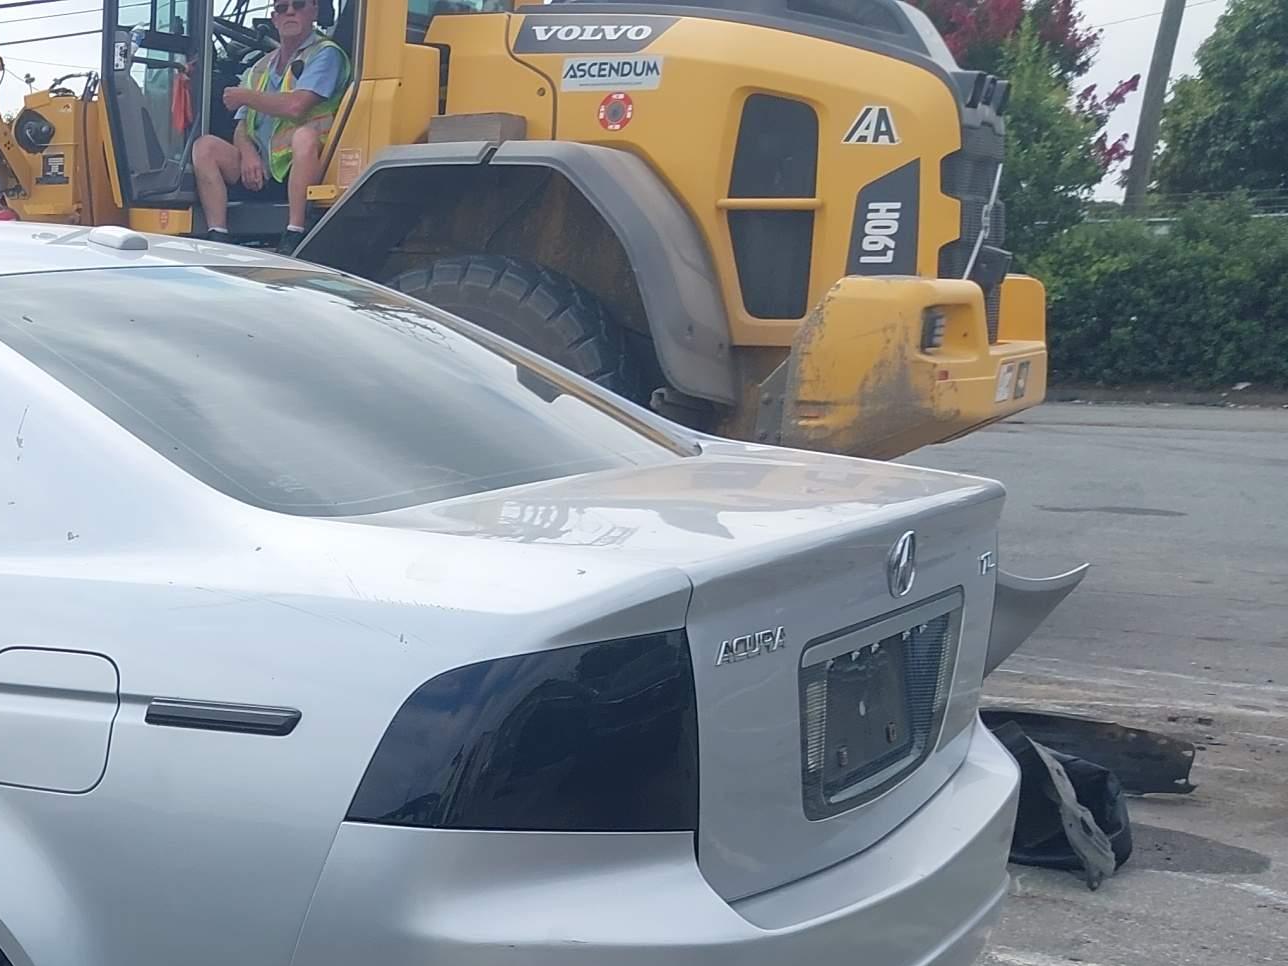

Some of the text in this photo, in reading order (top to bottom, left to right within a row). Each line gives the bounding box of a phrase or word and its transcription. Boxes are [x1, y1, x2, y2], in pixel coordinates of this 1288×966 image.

[532, 25, 653, 41] VOLVO
[563, 60, 660, 79] ASCENDUM
[859, 202, 902, 264] L90H
[715, 626, 786, 666] ACURA
